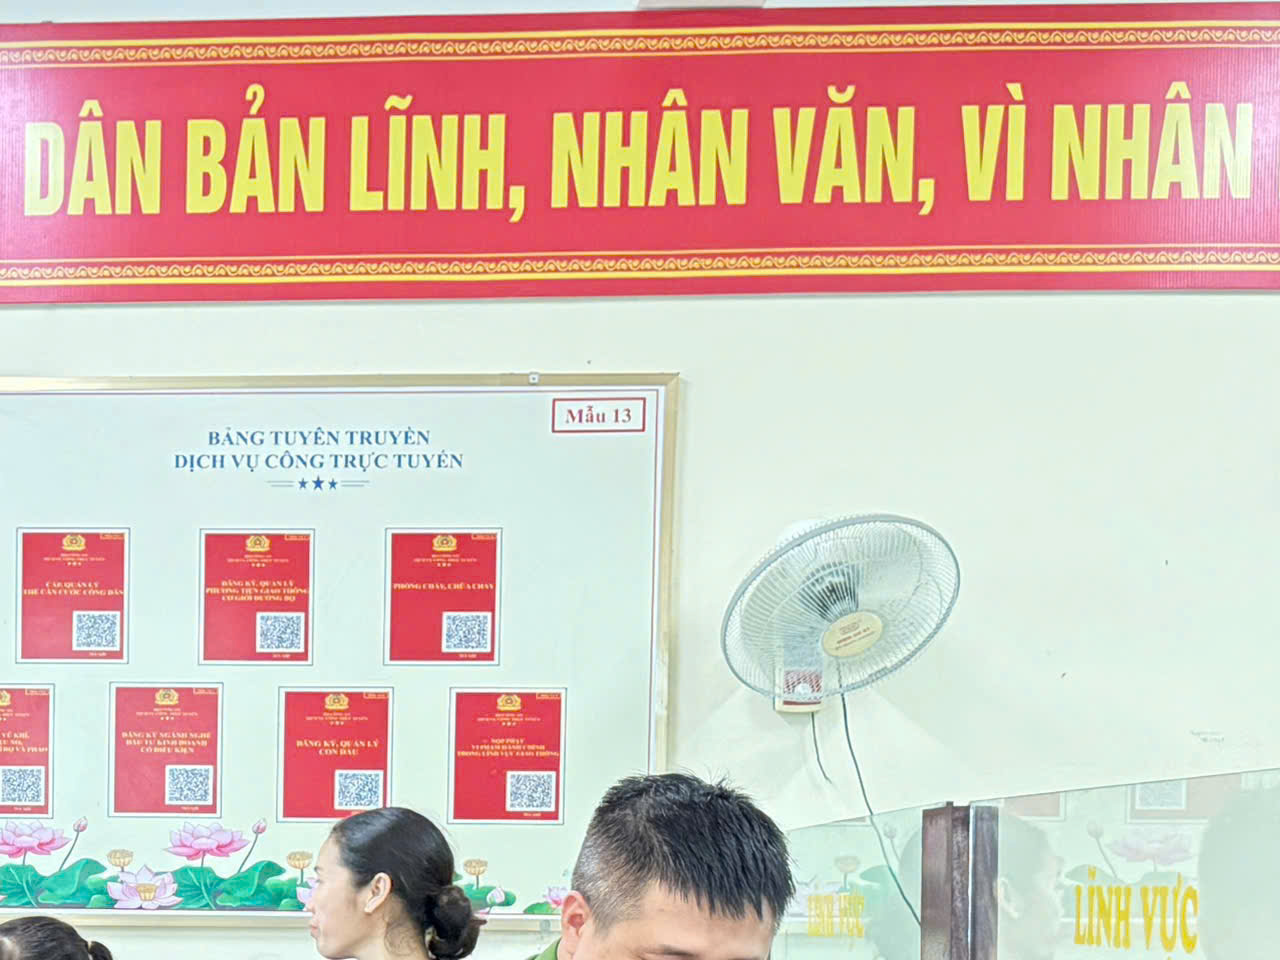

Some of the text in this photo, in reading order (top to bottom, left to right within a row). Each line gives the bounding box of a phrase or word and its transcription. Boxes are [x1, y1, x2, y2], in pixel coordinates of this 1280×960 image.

[22, 99, 161, 215] DÂN
[186, 84, 325, 214] BẢN
[350, 96, 525, 222] LĨNH,
[551, 89, 748, 208] NHÂN
[773, 85, 935, 215] VĂN,
[962, 83, 1026, 201] VÌ
[1053, 81, 1252, 200] NHÂN
[565, 405, 632, 424] Mẫu 13
[208, 427, 265, 446] BẢNG
[270, 427, 340, 446] TUYÊN
[175, 454, 225, 473] DỊCH
[231, 454, 259, 473] VỤ
[265, 450, 325, 469] CÔNG
[329, 451, 389, 473] TRỰC
[1073, 865, 1131, 950] LĨNH
